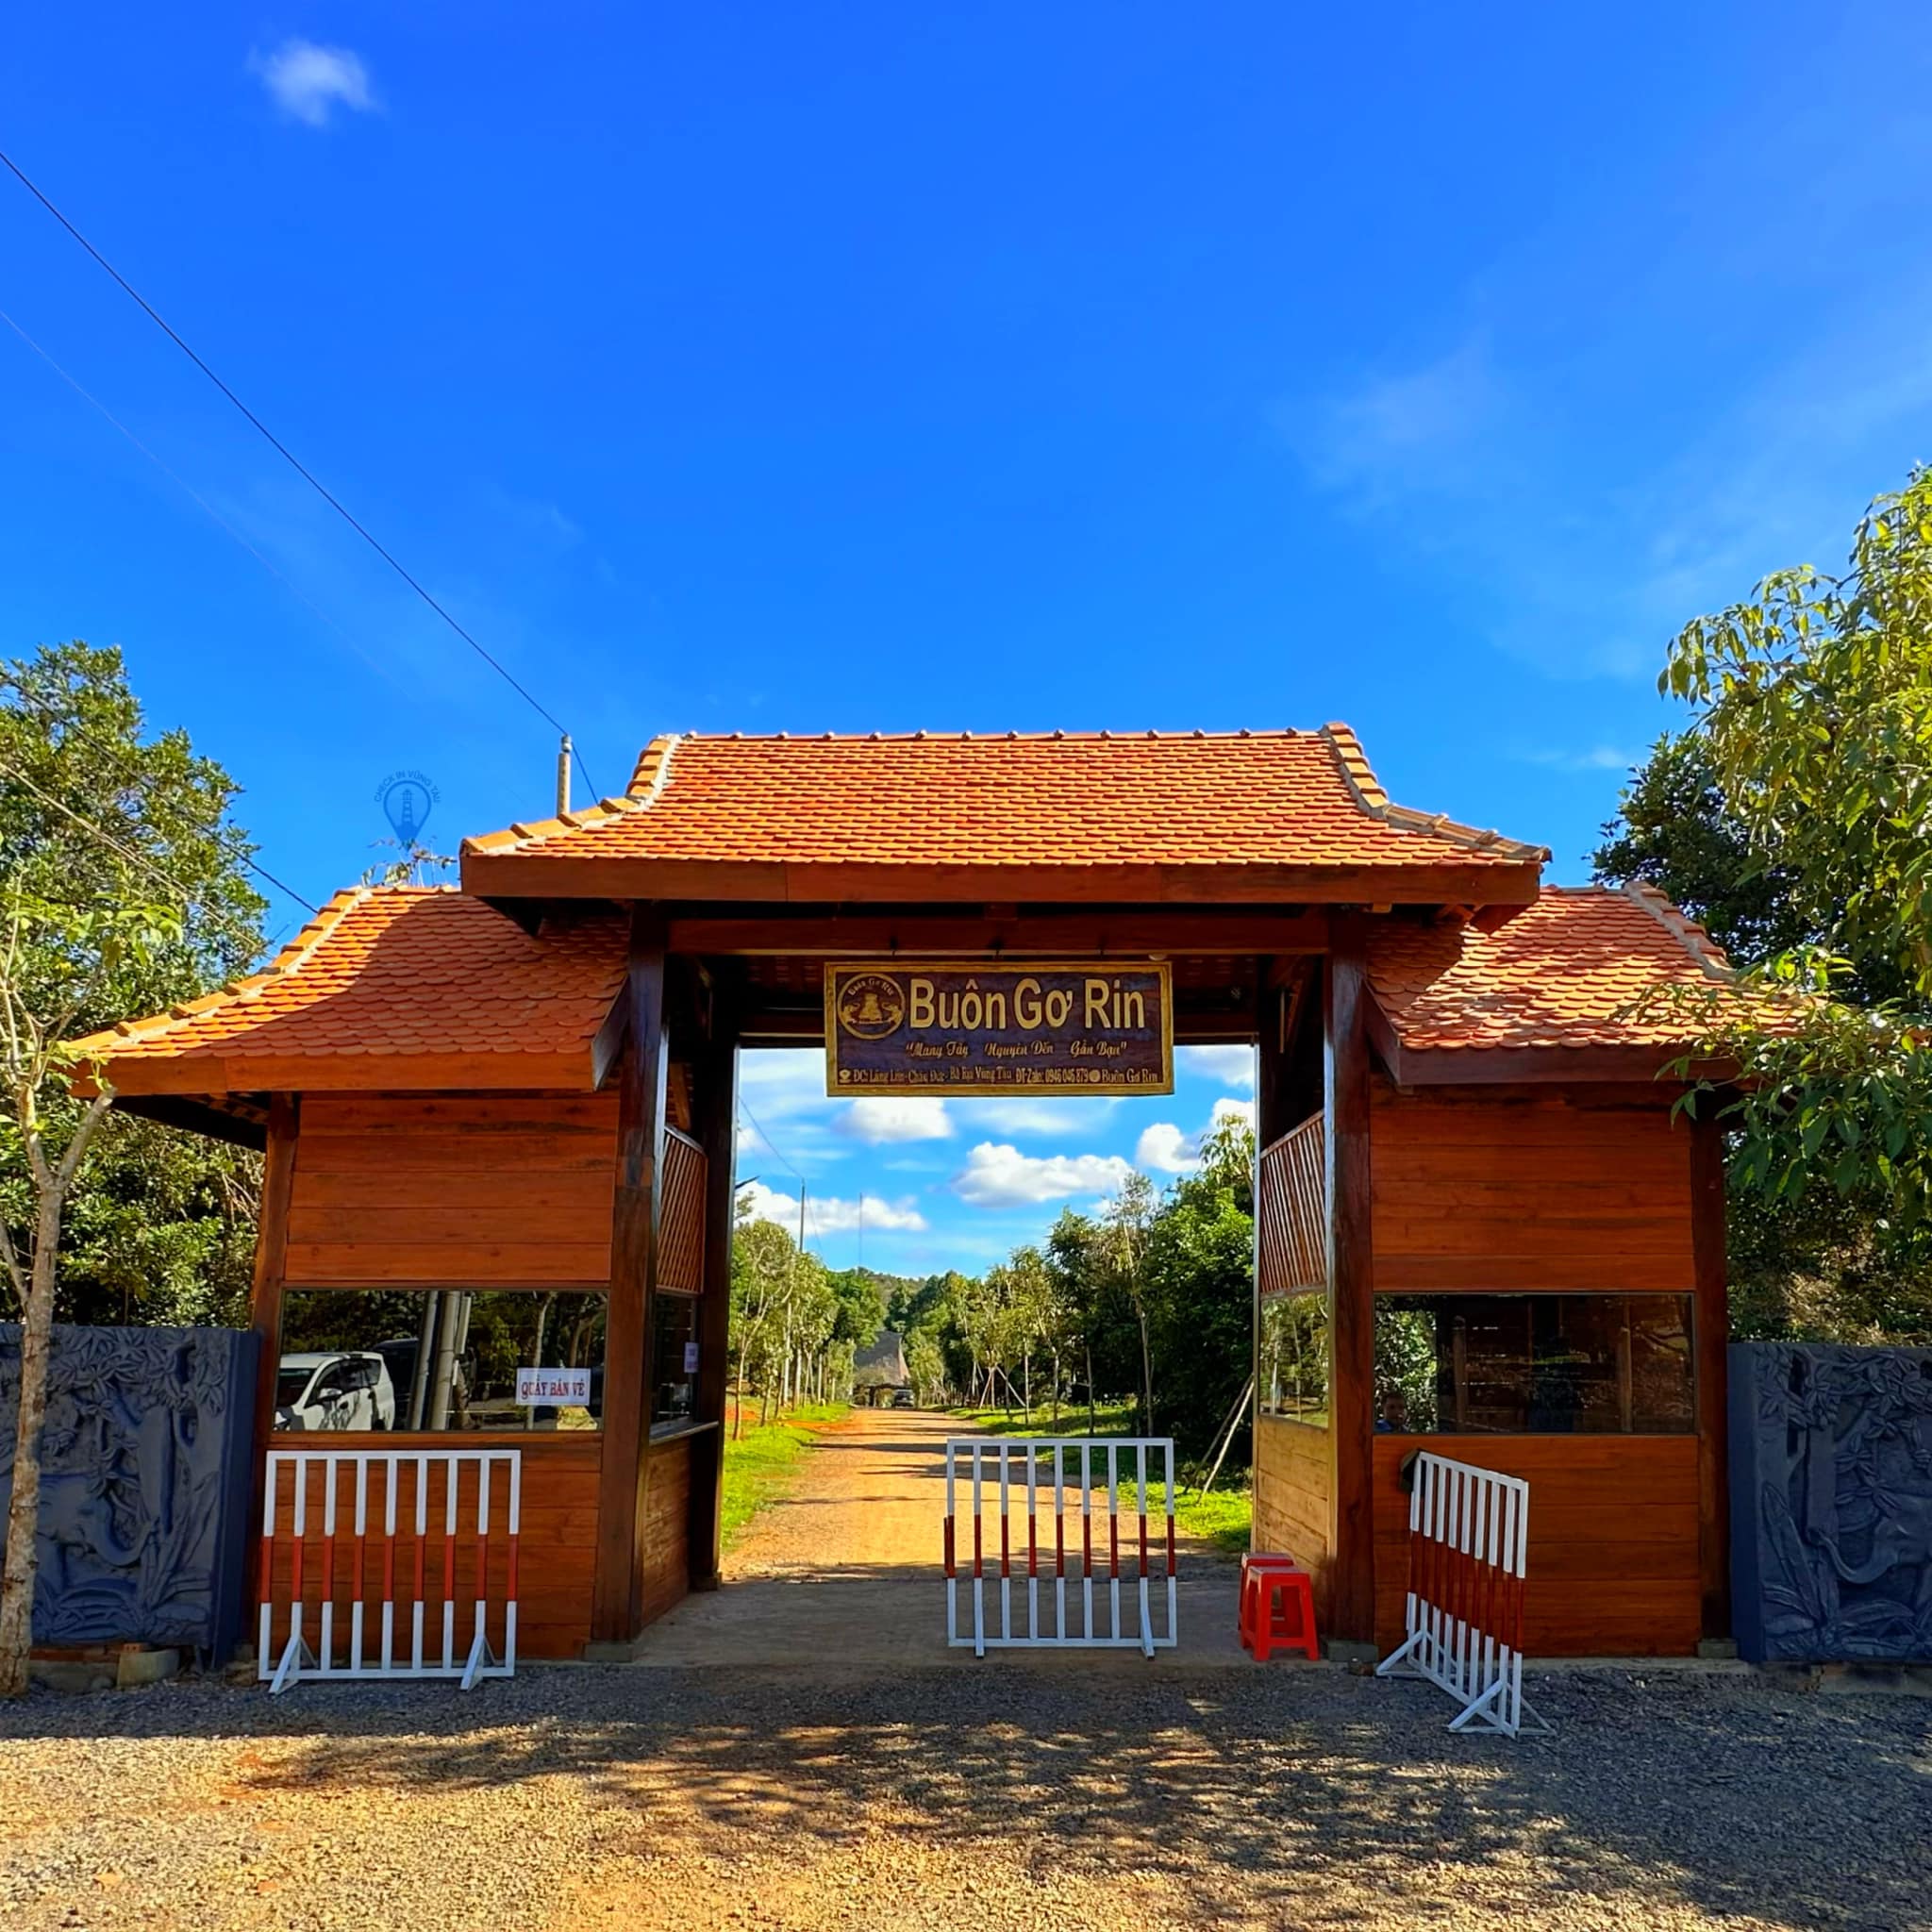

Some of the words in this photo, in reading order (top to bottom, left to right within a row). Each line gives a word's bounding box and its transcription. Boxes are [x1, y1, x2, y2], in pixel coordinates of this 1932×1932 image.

[909, 977, 1007, 1029] Buôn
[1013, 977, 1074, 1029] Gơ
[1084, 977, 1145, 1029] Rin
[550, 1377, 569, 1396] BÁN
[573, 1377, 585, 1396] VÉ
